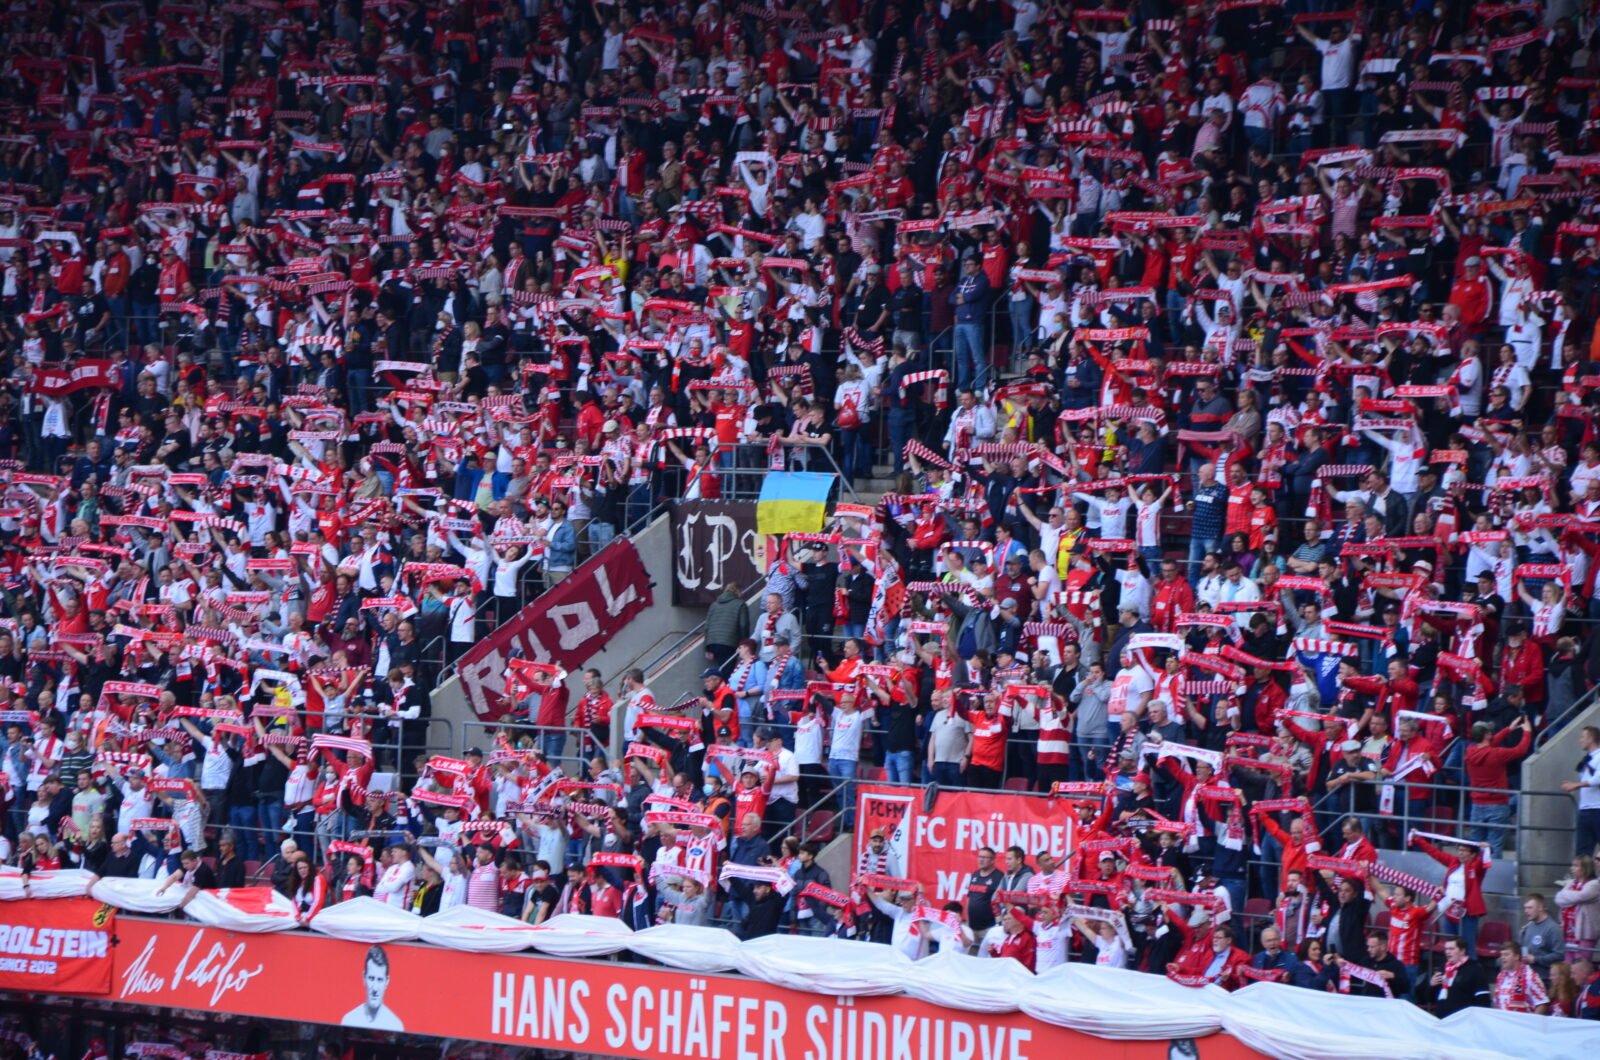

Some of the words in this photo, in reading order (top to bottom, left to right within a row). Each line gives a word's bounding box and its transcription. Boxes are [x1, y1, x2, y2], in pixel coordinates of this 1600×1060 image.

[869, 801, 905, 818] FCFM
[915, 815, 946, 849] FC
[955, 813, 1064, 858] FRÜNDE
[29, 960, 57, 974] 2012
[491, 971, 590, 1044] HANS
[605, 978, 787, 1060] SCHÄFER
